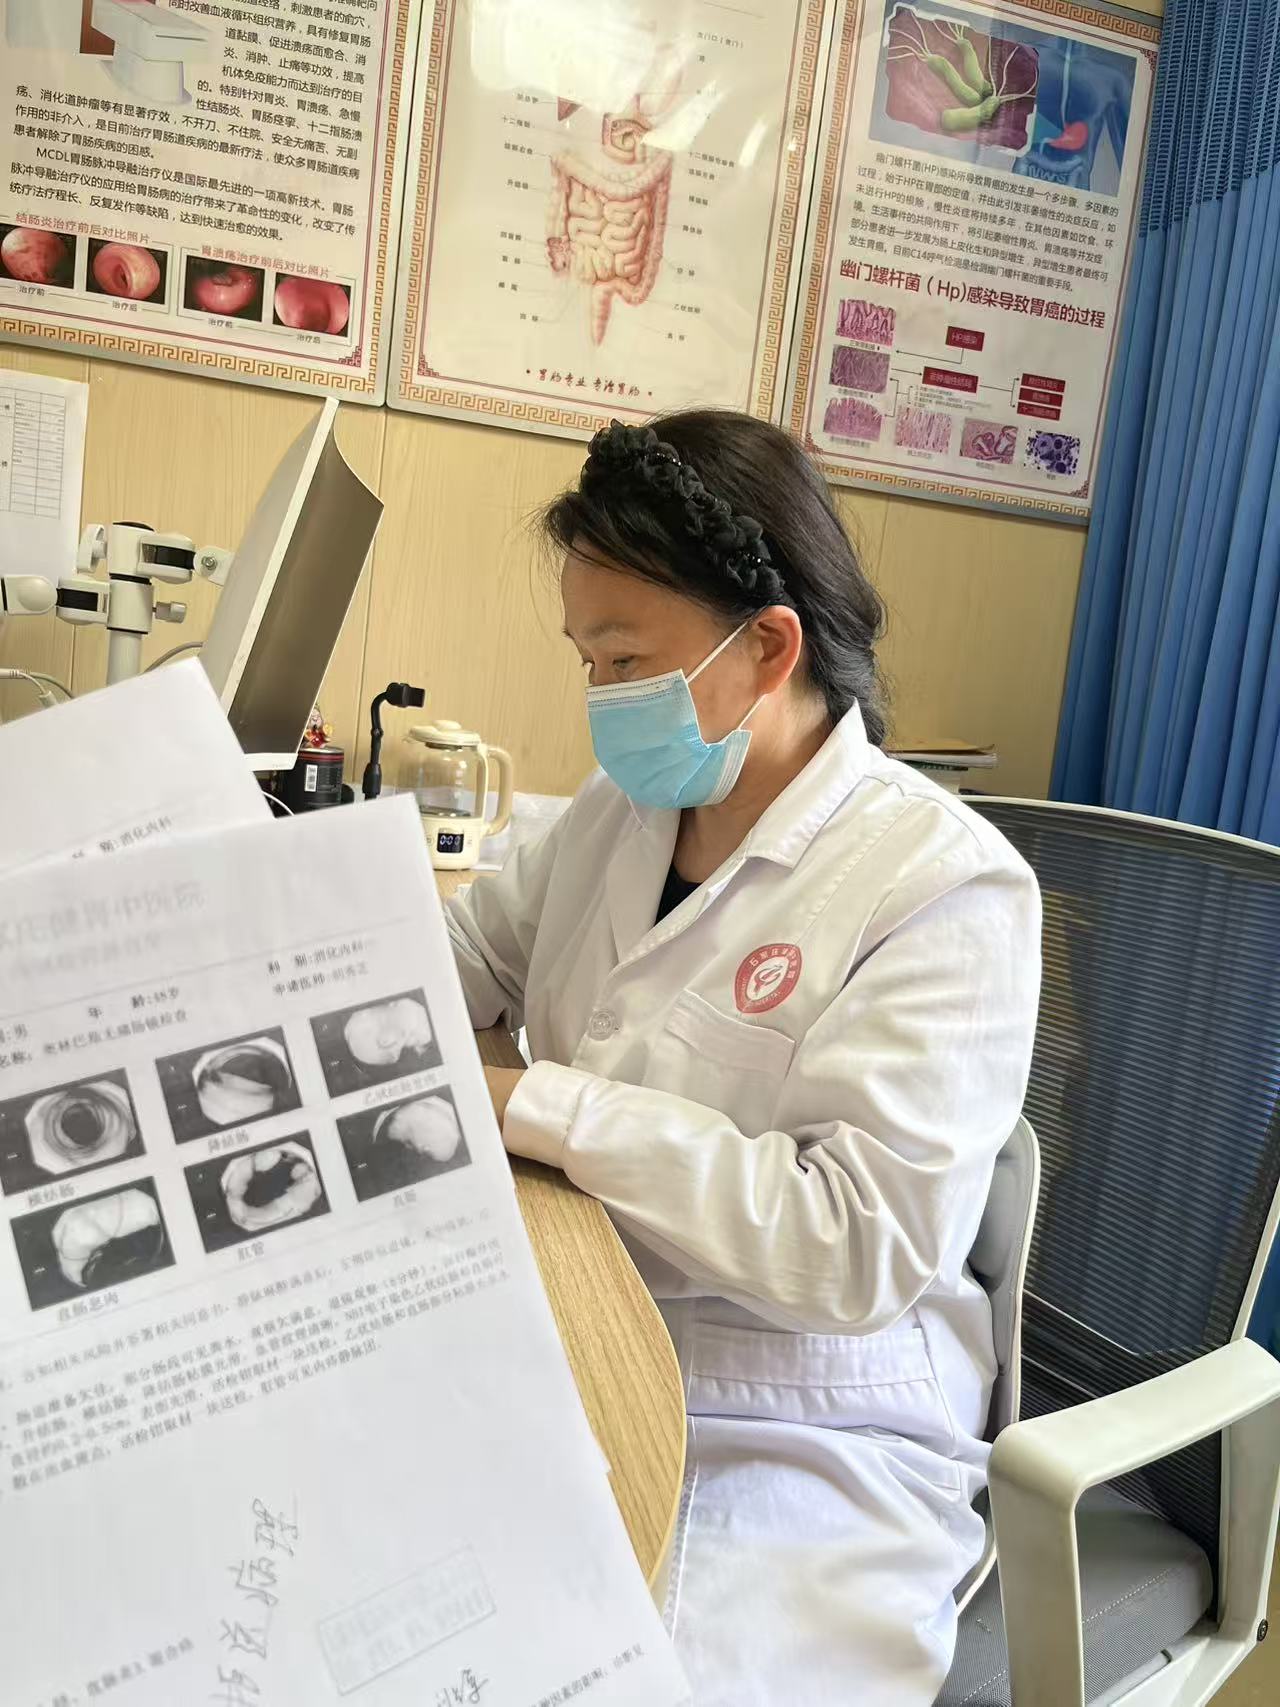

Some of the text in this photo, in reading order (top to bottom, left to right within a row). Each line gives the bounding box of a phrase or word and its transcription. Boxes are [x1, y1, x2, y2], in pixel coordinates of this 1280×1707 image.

[222, 65, 363, 104] 机体免疫能力而达到治疗的目
[13, 123, 155, 160] 患者解除了胃肠疾病的困惑。
[15, 213, 151, 244] 结肠炎治疗前后对比照片
[200, 244, 331, 279] 胃溃疡治疗前后对比照片
[18, 284, 46, 297] 治疗前
